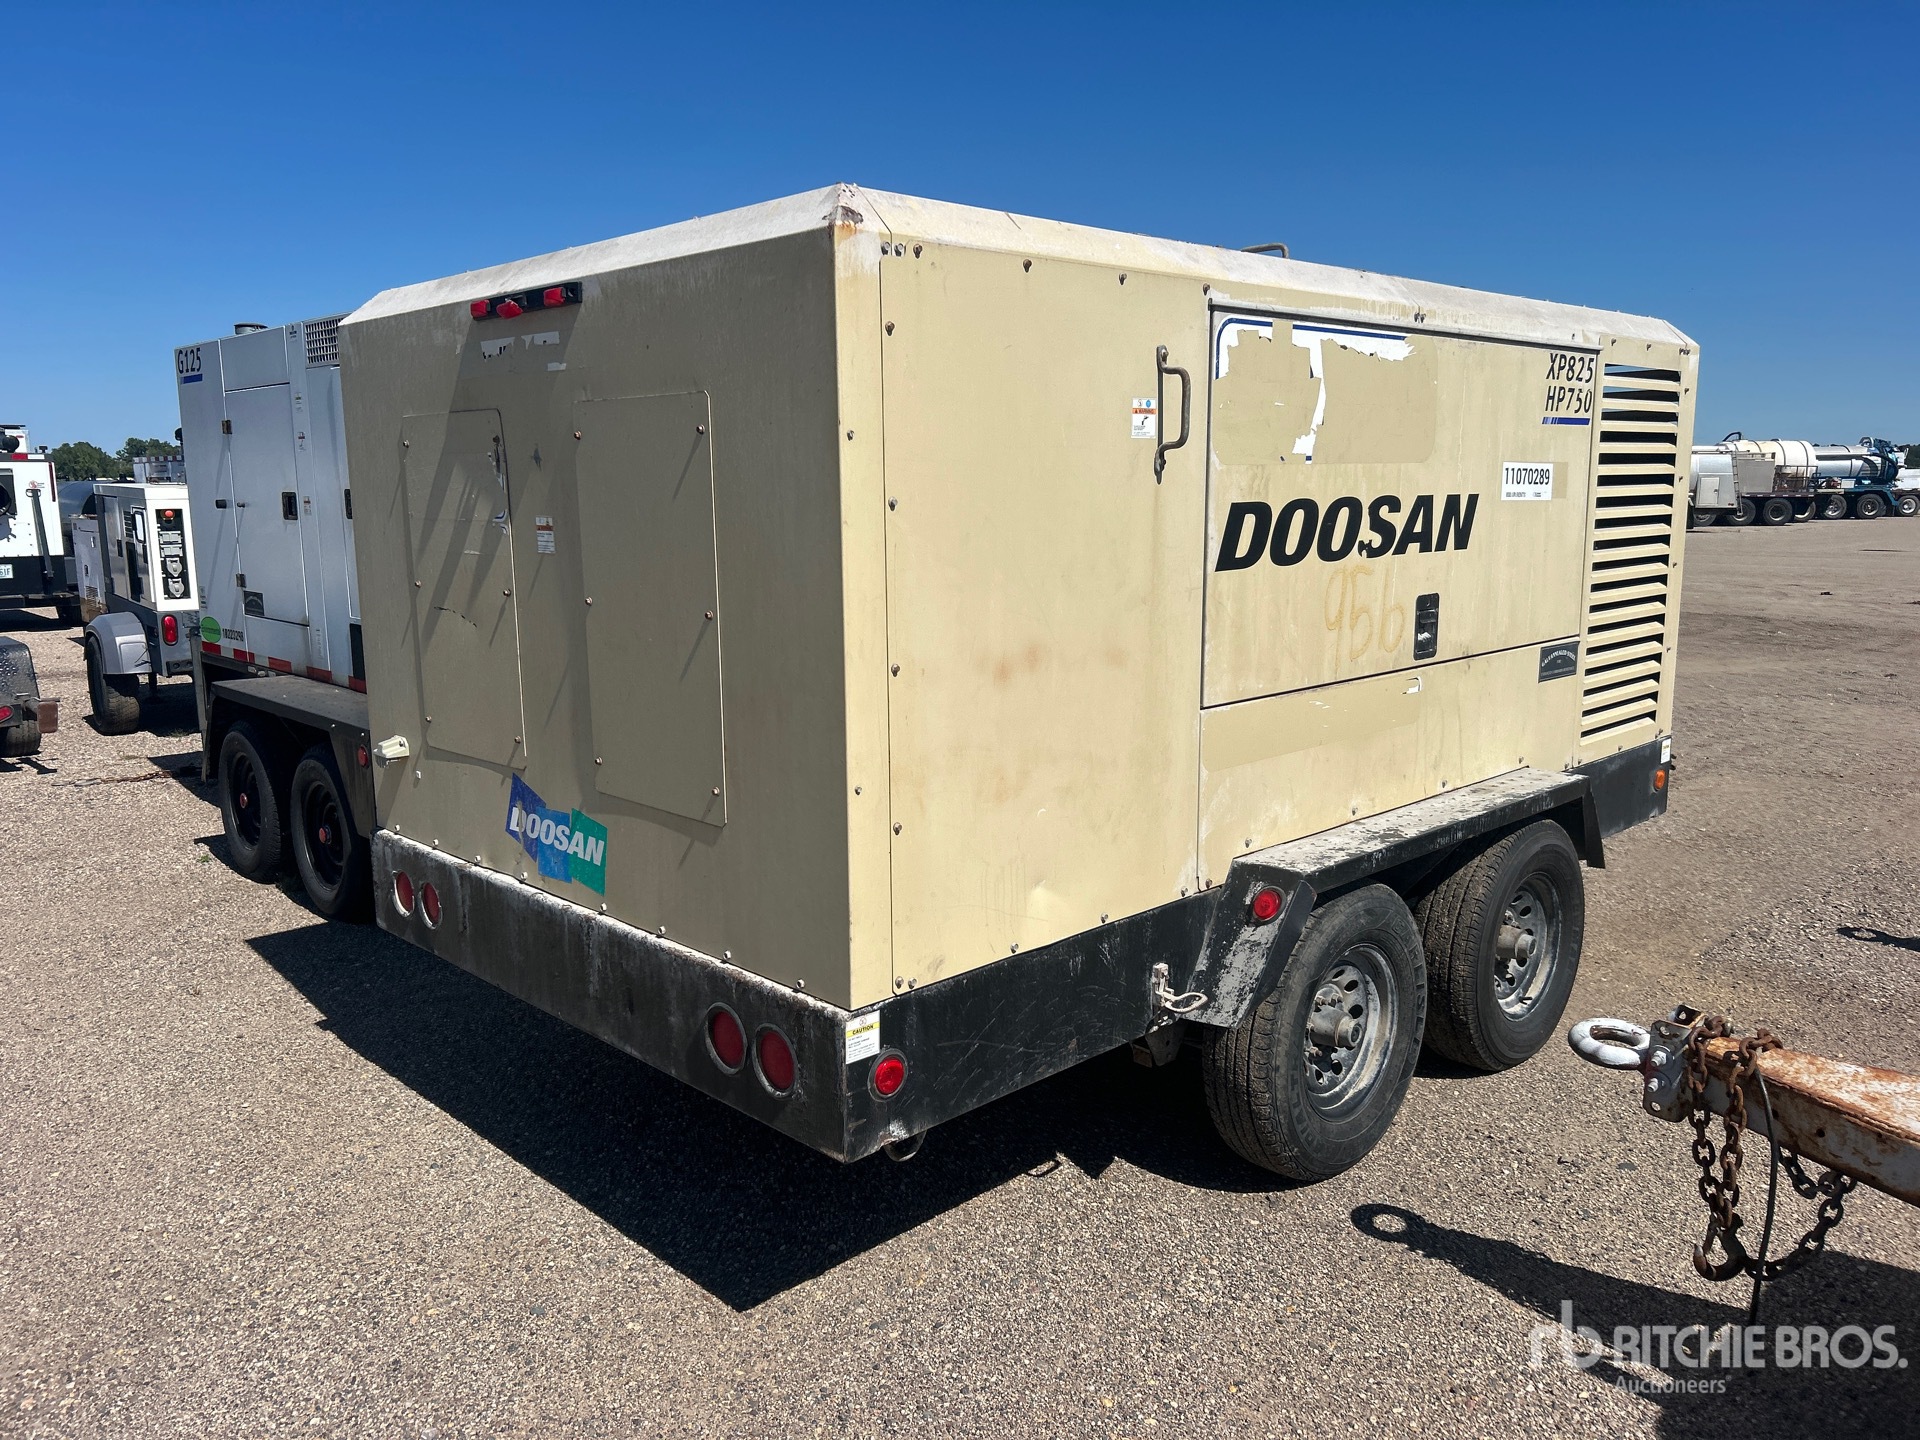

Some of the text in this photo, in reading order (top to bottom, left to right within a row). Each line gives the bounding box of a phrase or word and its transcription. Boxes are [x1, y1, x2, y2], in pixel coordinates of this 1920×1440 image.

[177, 347, 202, 374] G125
[1546, 353, 1595, 383] XP825
[1545, 385, 1592, 414] HP750
[1505, 467, 1550, 485] 11070289
[1214, 493, 1479, 572] DOOSAN
[509, 806, 605, 867] DOOSAN
[852, 1024, 874, 1035] CAUTION
